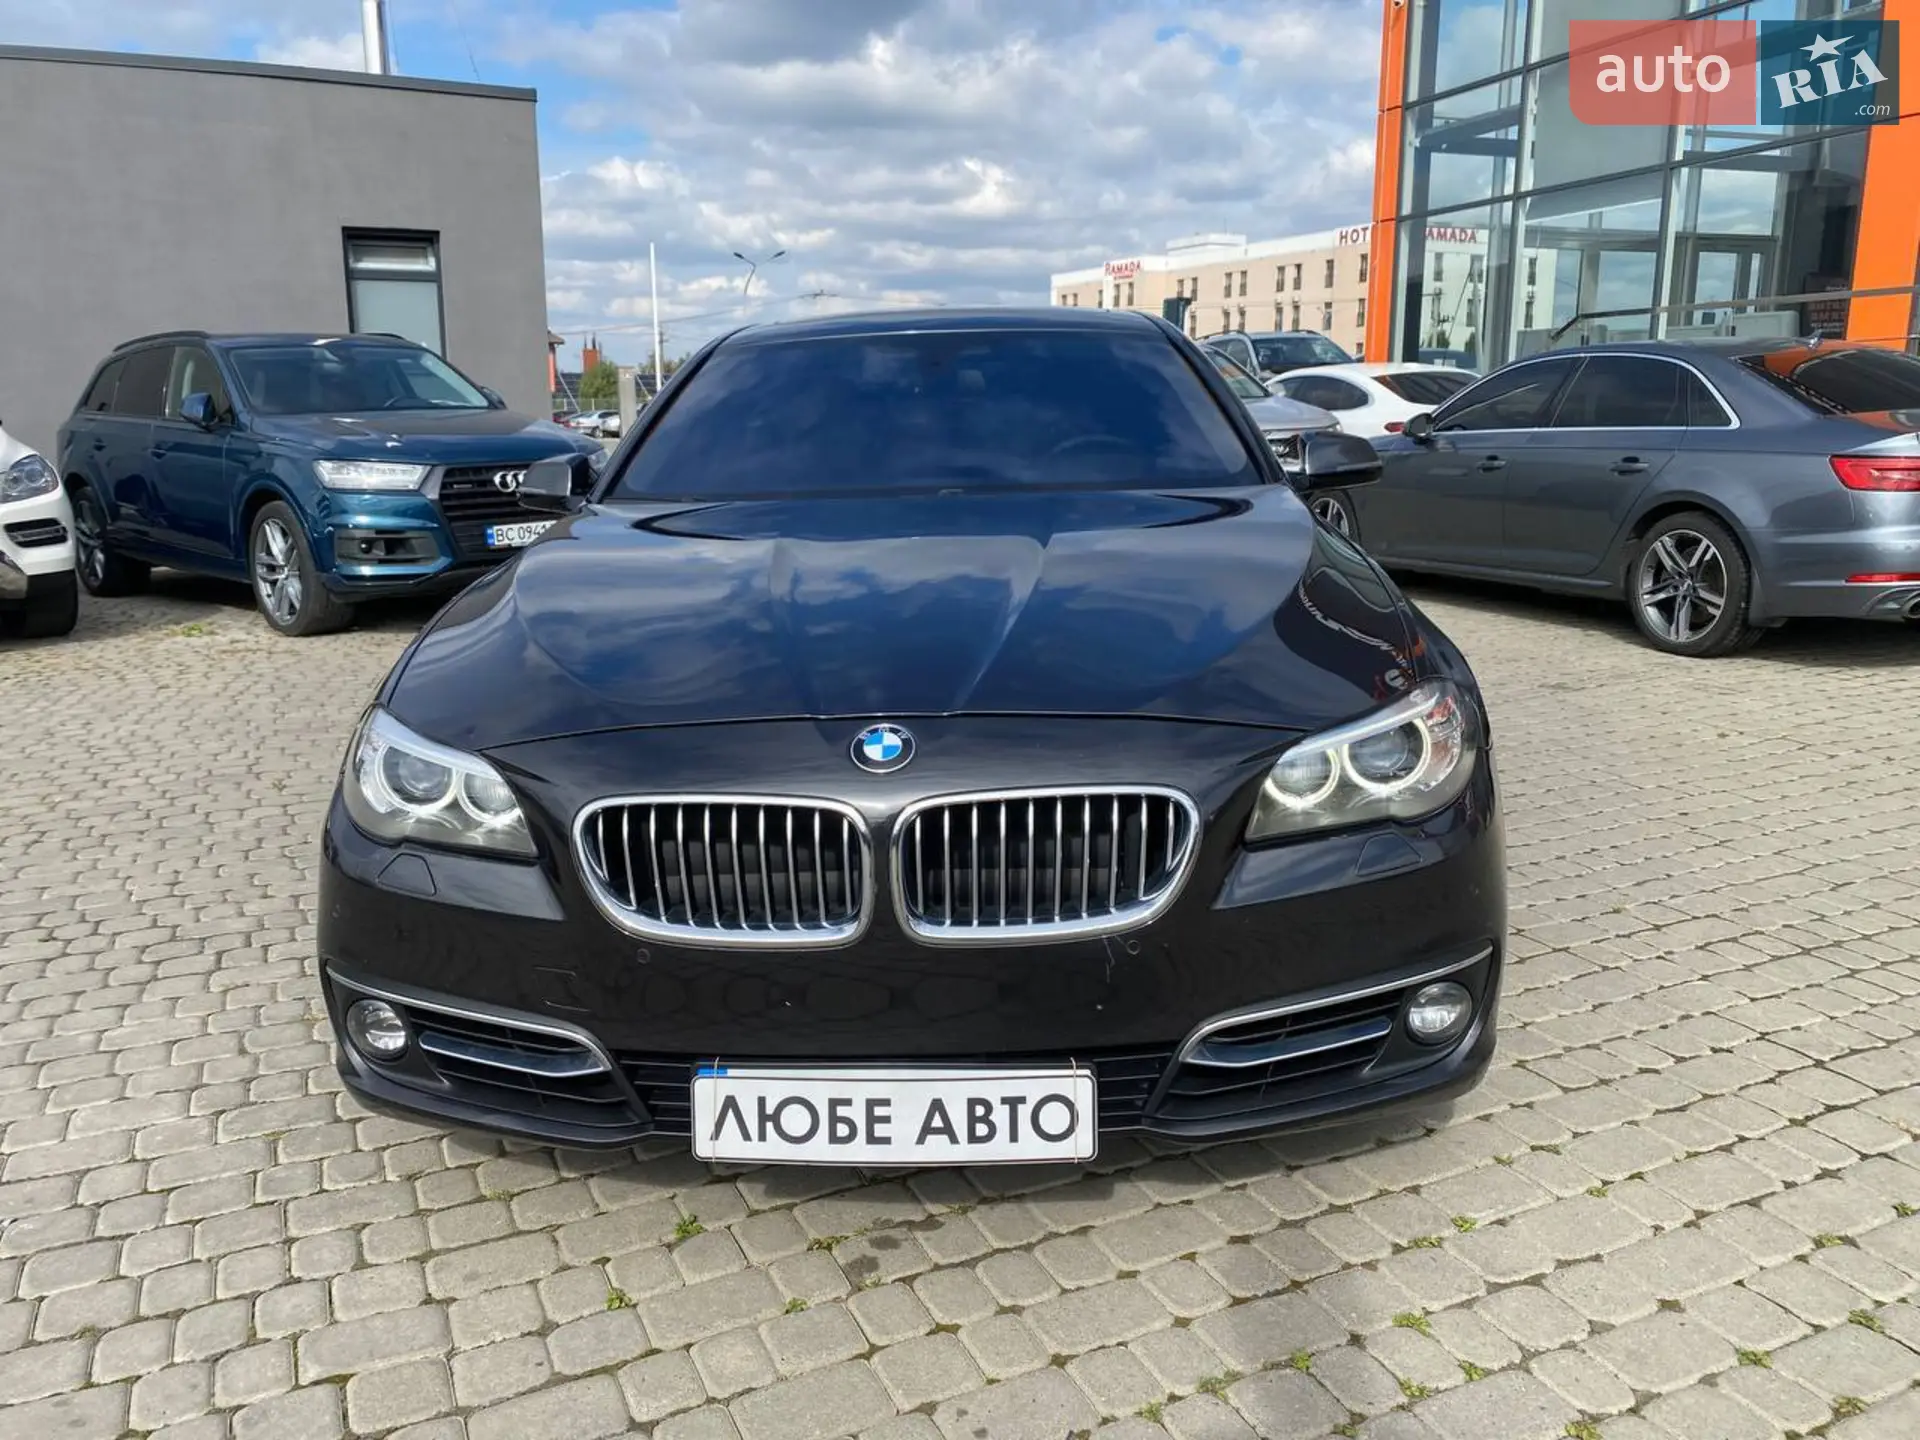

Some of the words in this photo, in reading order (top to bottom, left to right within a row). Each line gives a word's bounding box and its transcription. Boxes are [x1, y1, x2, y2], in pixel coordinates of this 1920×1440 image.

[1423, 227, 1477, 243] AMADA
[1104, 260, 1141, 276] RAMADA
[709, 1094, 893, 1145] ЛЮБЕ
[915, 1092, 1080, 1145] АВТО
